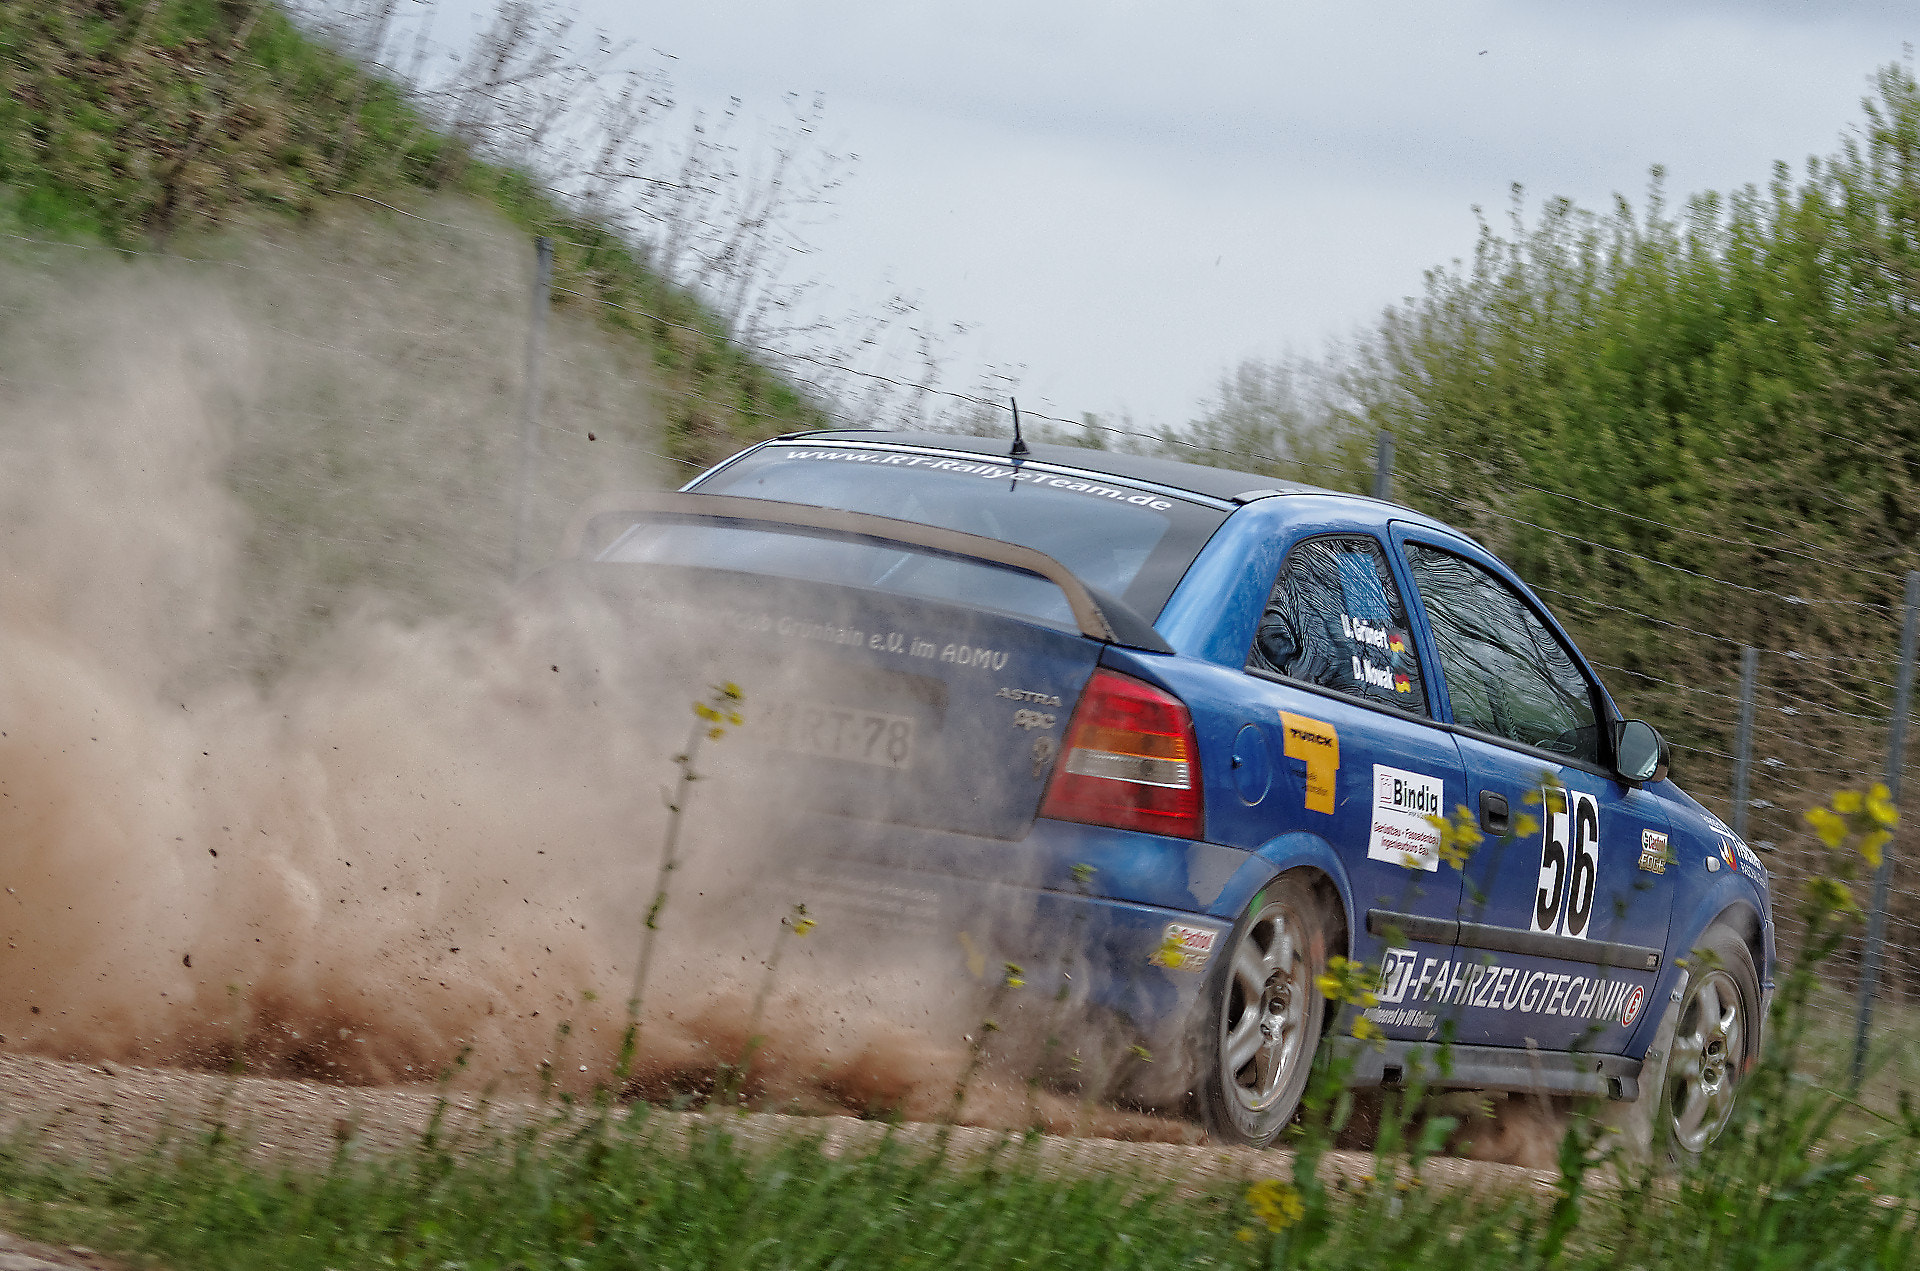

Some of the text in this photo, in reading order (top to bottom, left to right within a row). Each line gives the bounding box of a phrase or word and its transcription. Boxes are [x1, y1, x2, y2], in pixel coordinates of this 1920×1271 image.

[785, 450, 1172, 512] www.RT-RallyeTeam.de
[994, 686, 1063, 708] ASTRA
[863, 716, 910, 762] 78
[1393, 778, 1439, 815] Bindig
[1537, 791, 1598, 937] 56
